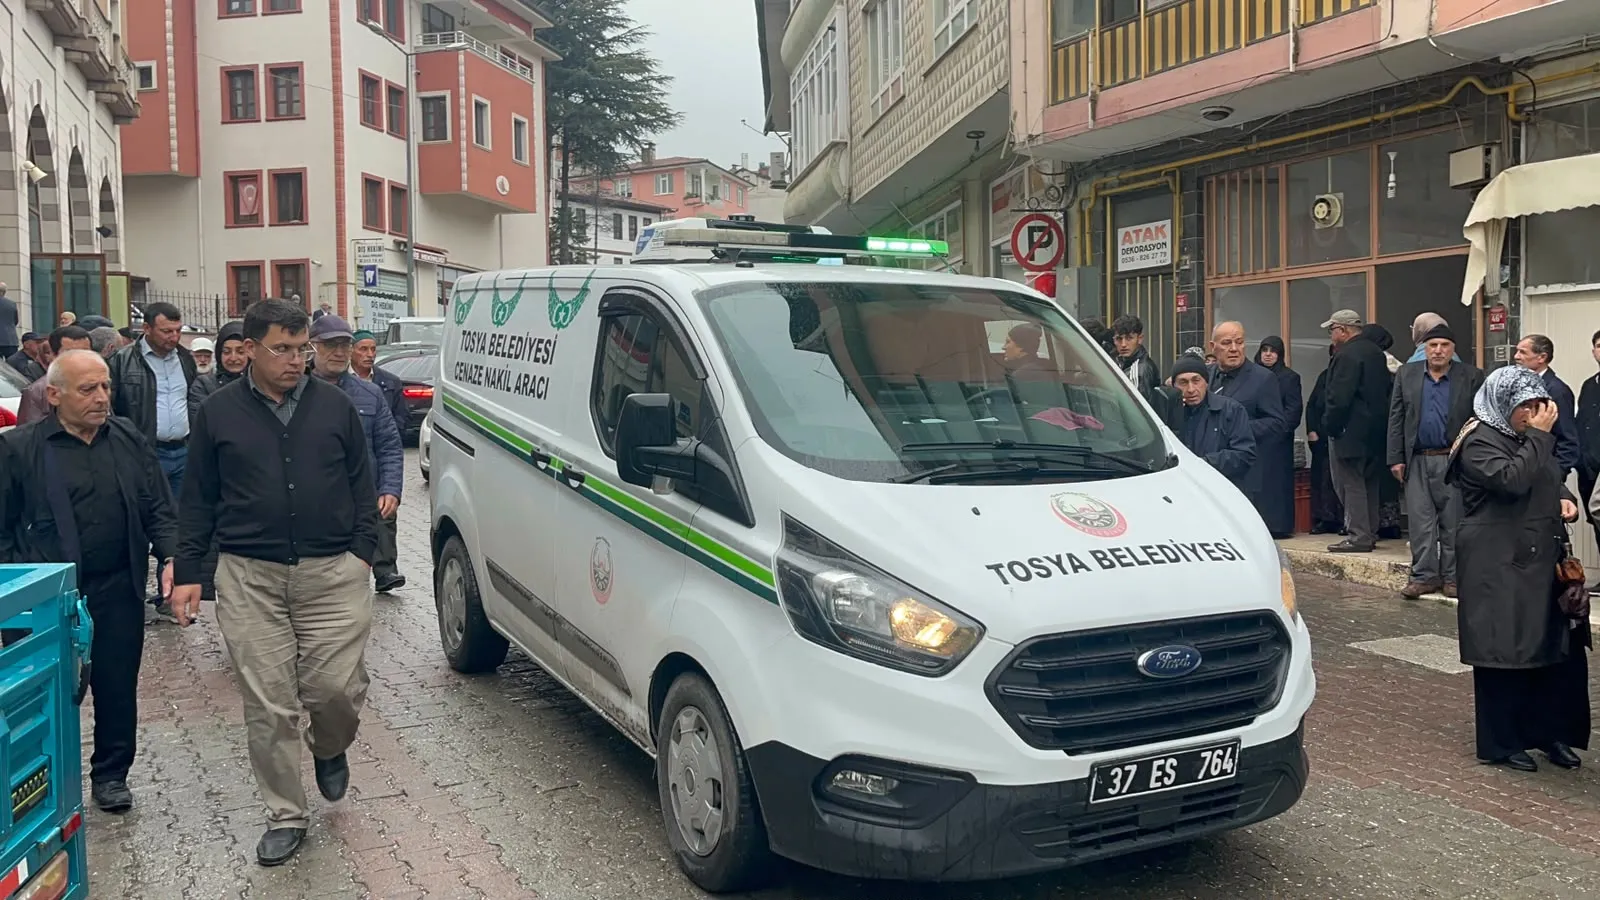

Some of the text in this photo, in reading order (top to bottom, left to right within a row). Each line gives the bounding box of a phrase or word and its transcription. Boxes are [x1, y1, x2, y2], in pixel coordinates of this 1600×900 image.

[1027, 225, 1054, 262] P
[1121, 224, 1168, 246] ATAK
[1121, 241, 1168, 256] DEKORASYON
[460, 329, 558, 366] TOSYA BELEDİYESİ
[454, 361, 550, 401] CENAZE NAKİL ARACI
[985, 537, 1247, 586] TOSYA BELEDİYESİ
[1156, 650, 1192, 670] Ford
[1107, 747, 1235, 796] 37 ES 764
